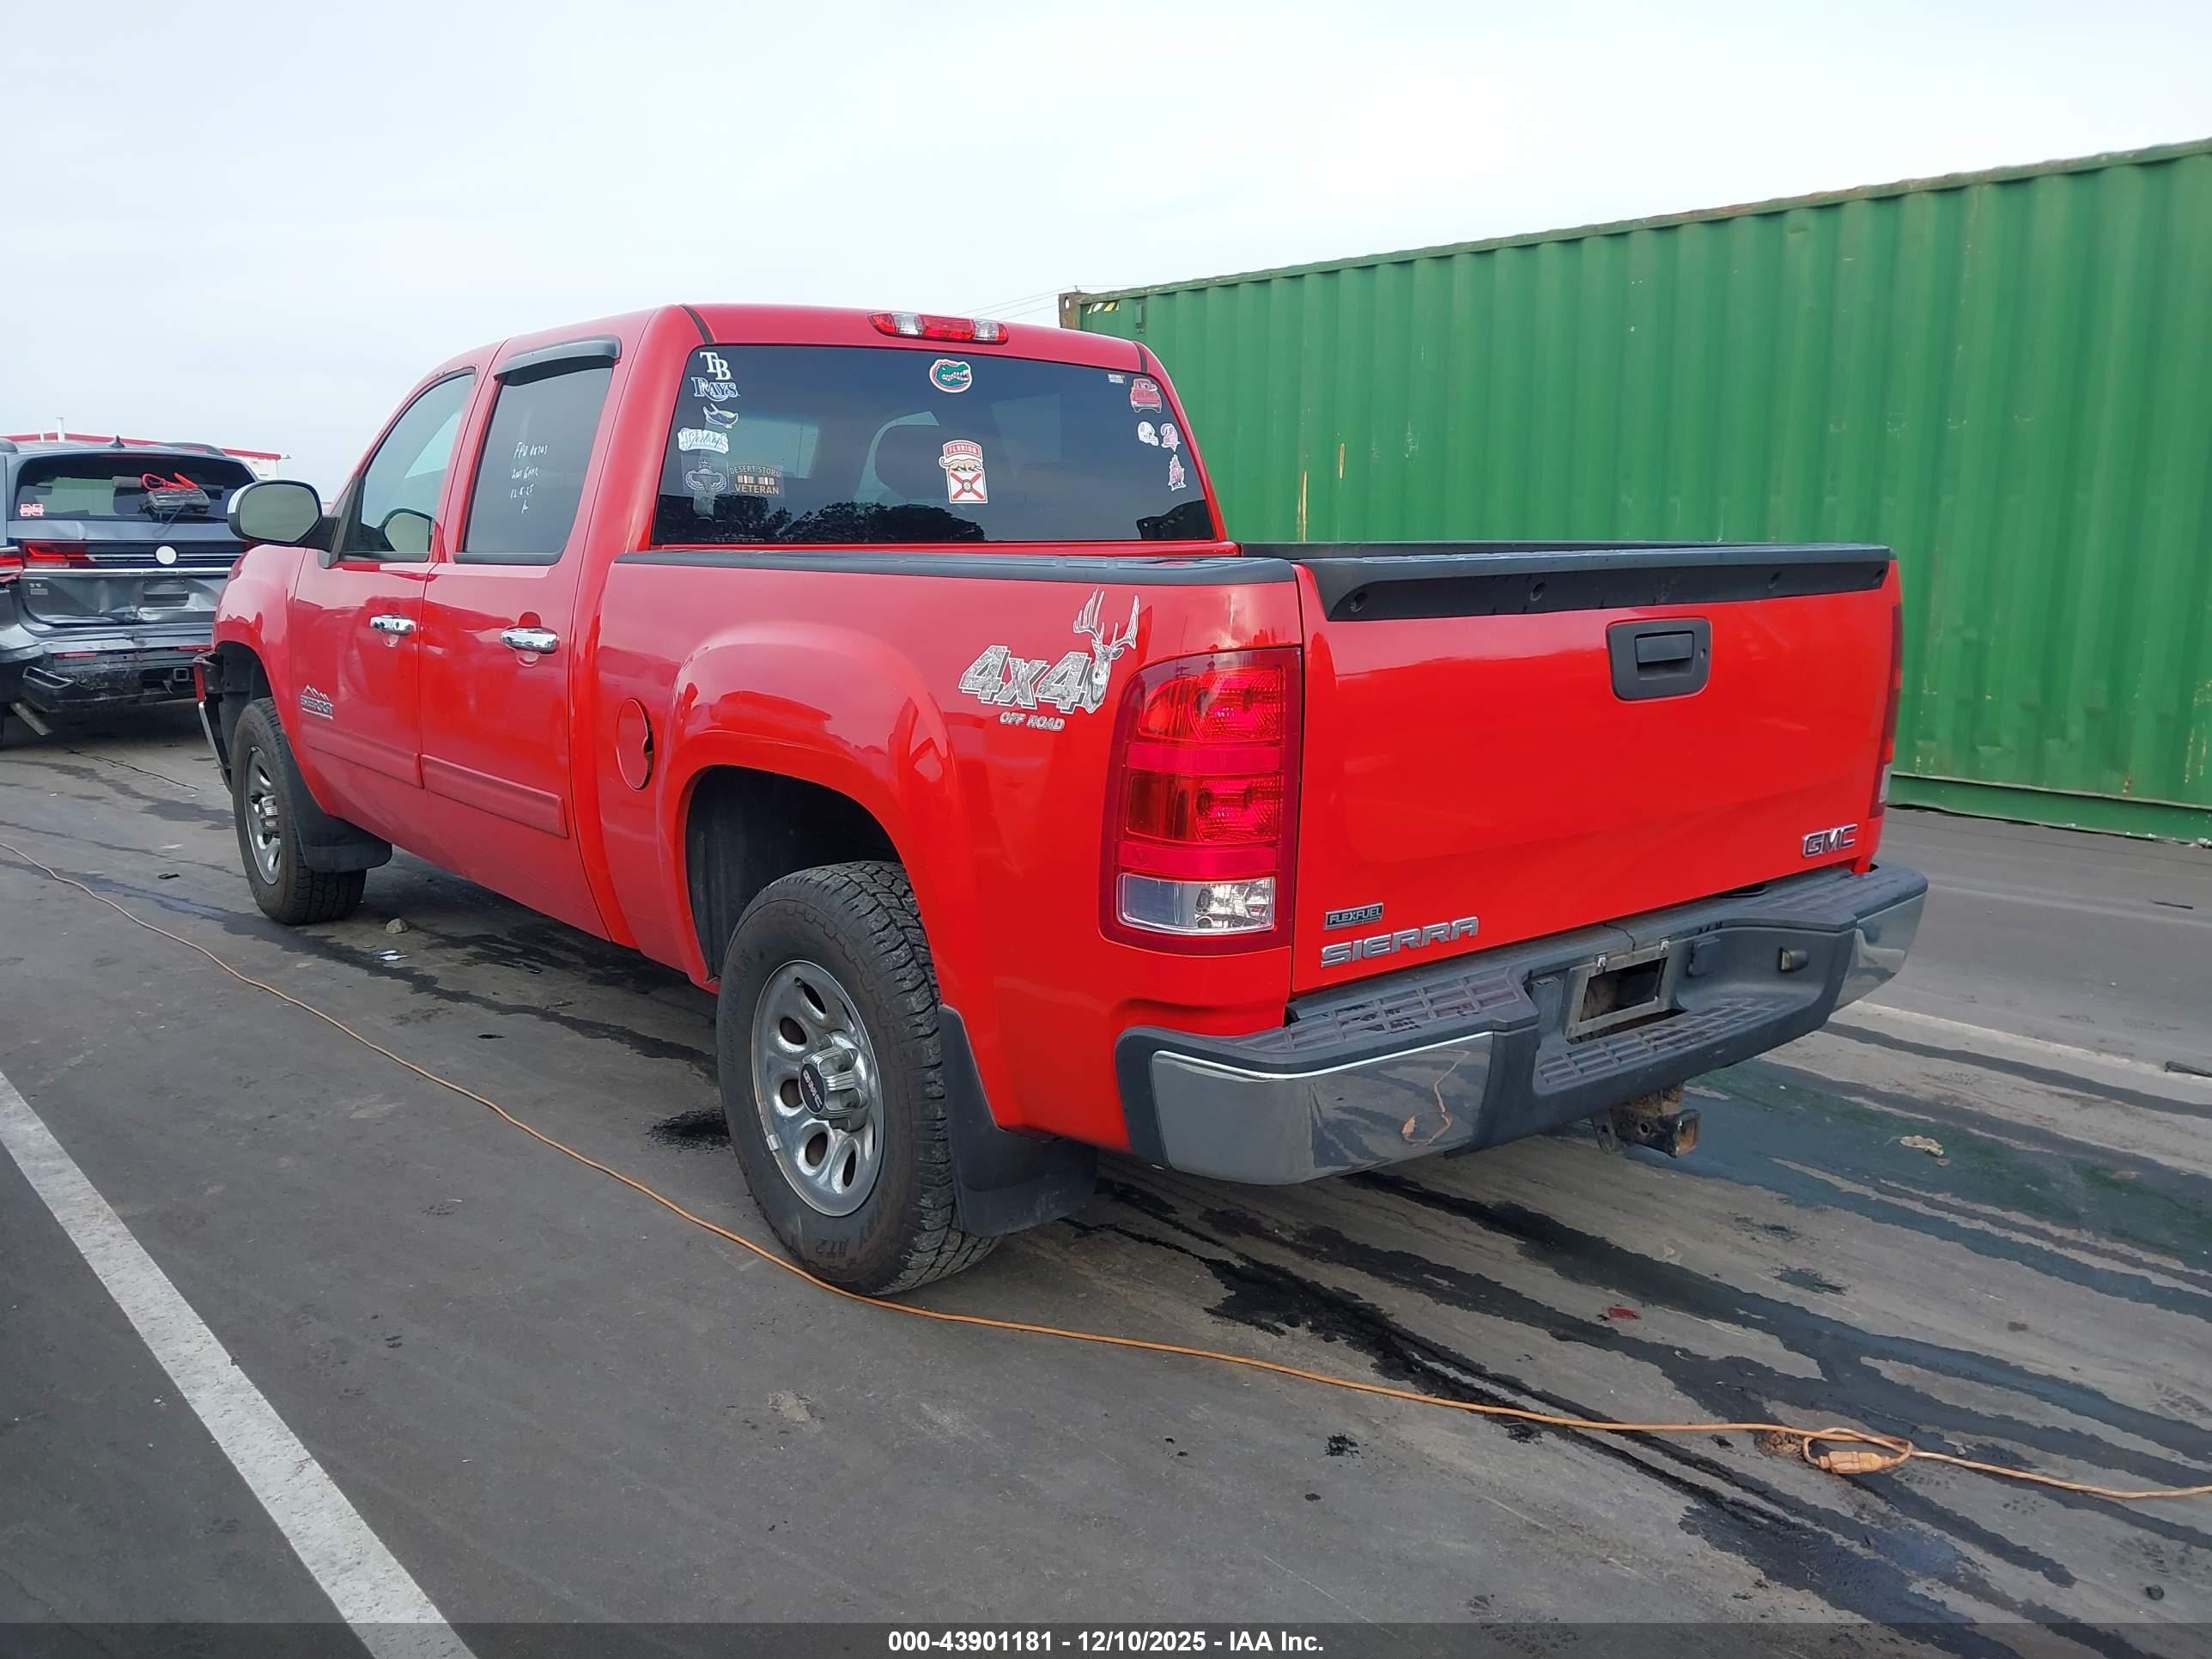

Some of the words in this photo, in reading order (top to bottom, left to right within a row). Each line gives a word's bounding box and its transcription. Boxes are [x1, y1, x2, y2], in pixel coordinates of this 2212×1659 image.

[949, 444, 977, 454] FLORIDA
[730, 465, 756, 475] DESERT
[757, 465, 782, 477] STORM
[735, 484, 779, 495] VETERAN
[1000, 711, 1026, 726] OFF
[1027, 714, 1066, 731] ROAD
[1802, 823, 1858, 858] GMC
[1329, 906, 1382, 924] FLEXFUEL
[1321, 916, 1479, 968] SIERRA
[803, 1069, 823, 1109] GMC
